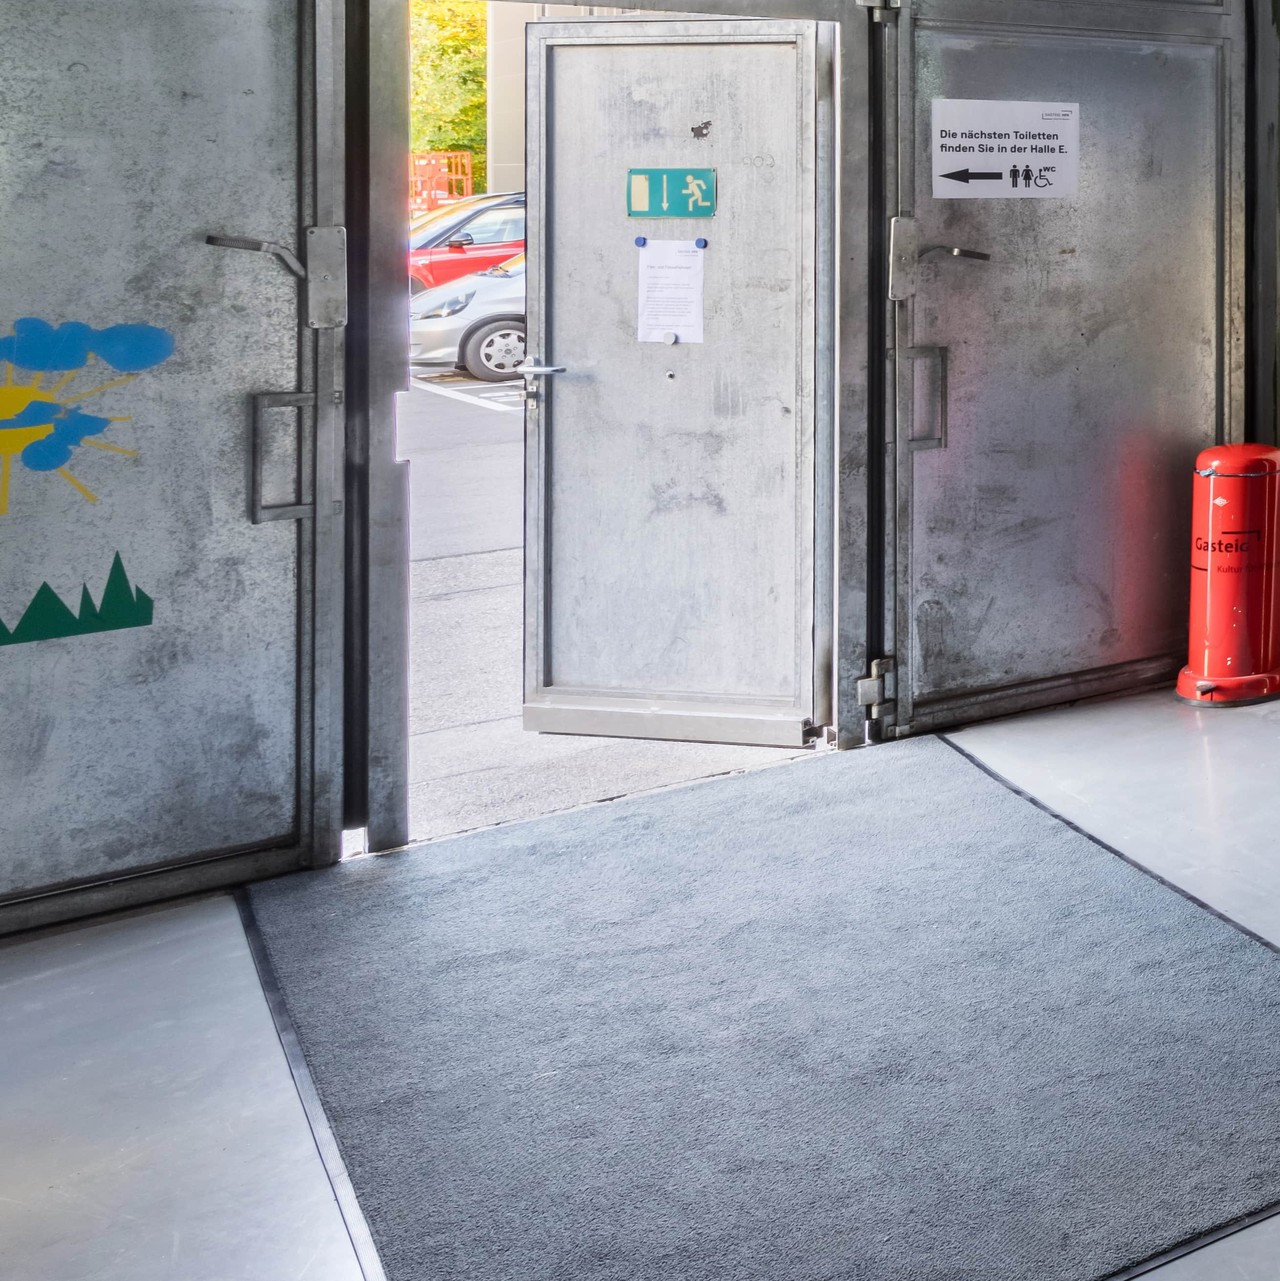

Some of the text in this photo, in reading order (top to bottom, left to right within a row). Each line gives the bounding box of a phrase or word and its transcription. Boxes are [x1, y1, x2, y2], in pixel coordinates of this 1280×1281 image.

[940, 130, 1059, 140] Die nächsten Toiletten
[940, 143, 1068, 154] finden Sie in der Halle E.
